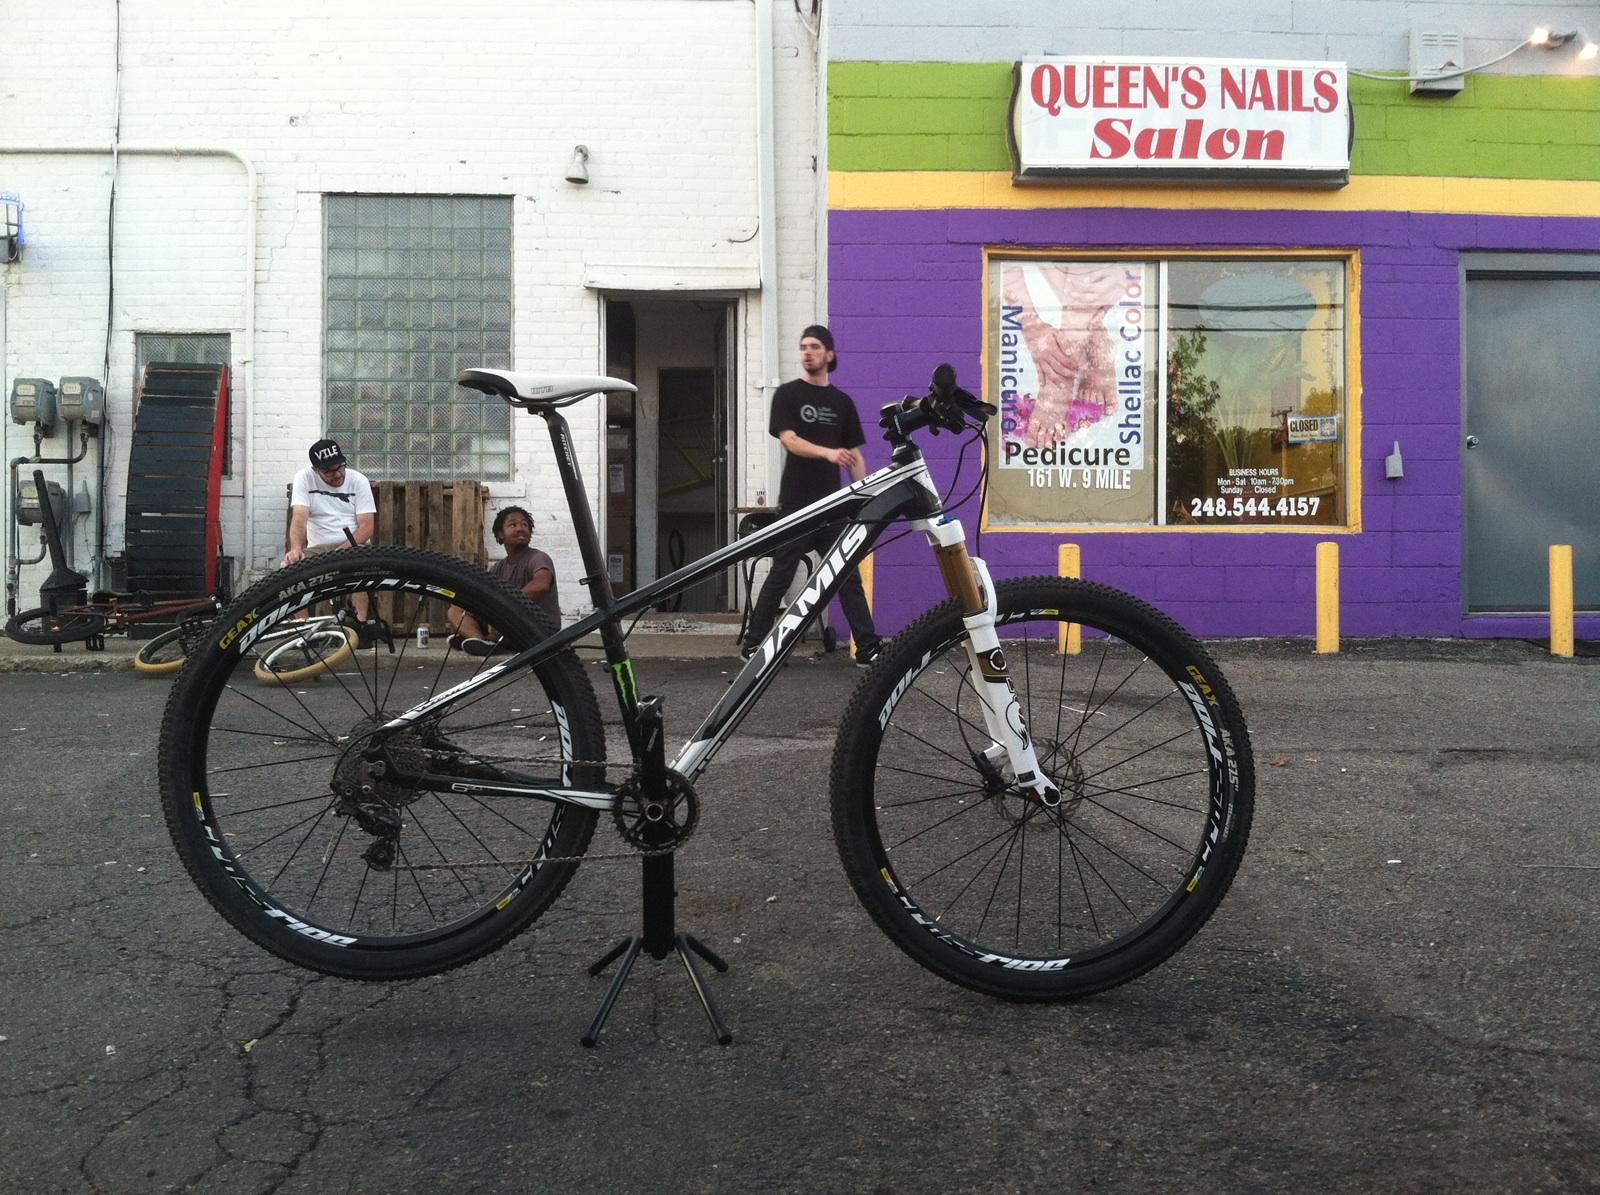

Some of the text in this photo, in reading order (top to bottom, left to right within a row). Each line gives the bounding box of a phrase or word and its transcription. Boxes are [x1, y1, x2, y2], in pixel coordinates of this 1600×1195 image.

[1030, 63, 1339, 116] QUEEN'S NAILS
[1089, 117, 1285, 161] Salon
[1001, 305, 1023, 433] Manicure
[1118, 270, 1142, 445] Shellac Color
[1290, 419, 1318, 432] CLOSED
[314, 444, 339, 461] VILE
[1005, 441, 1131, 466] Pedicure
[1027, 468, 1131, 490] 161 W. 9 MILE
[1217, 477, 1231, 486] Mon
[1235, 477, 1246, 486] Sat
[1228, 468, 1279, 476] BUSINESS HOURS
[1254, 486, 1277, 494] Closed
[1191, 497, 1320, 517] 248.544.4157
[278, 581, 307, 601] AKA
[755, 523, 868, 679] JAMIS
[218, 607, 259, 651] GEAX
[1185, 664, 1220, 711] GEAX
